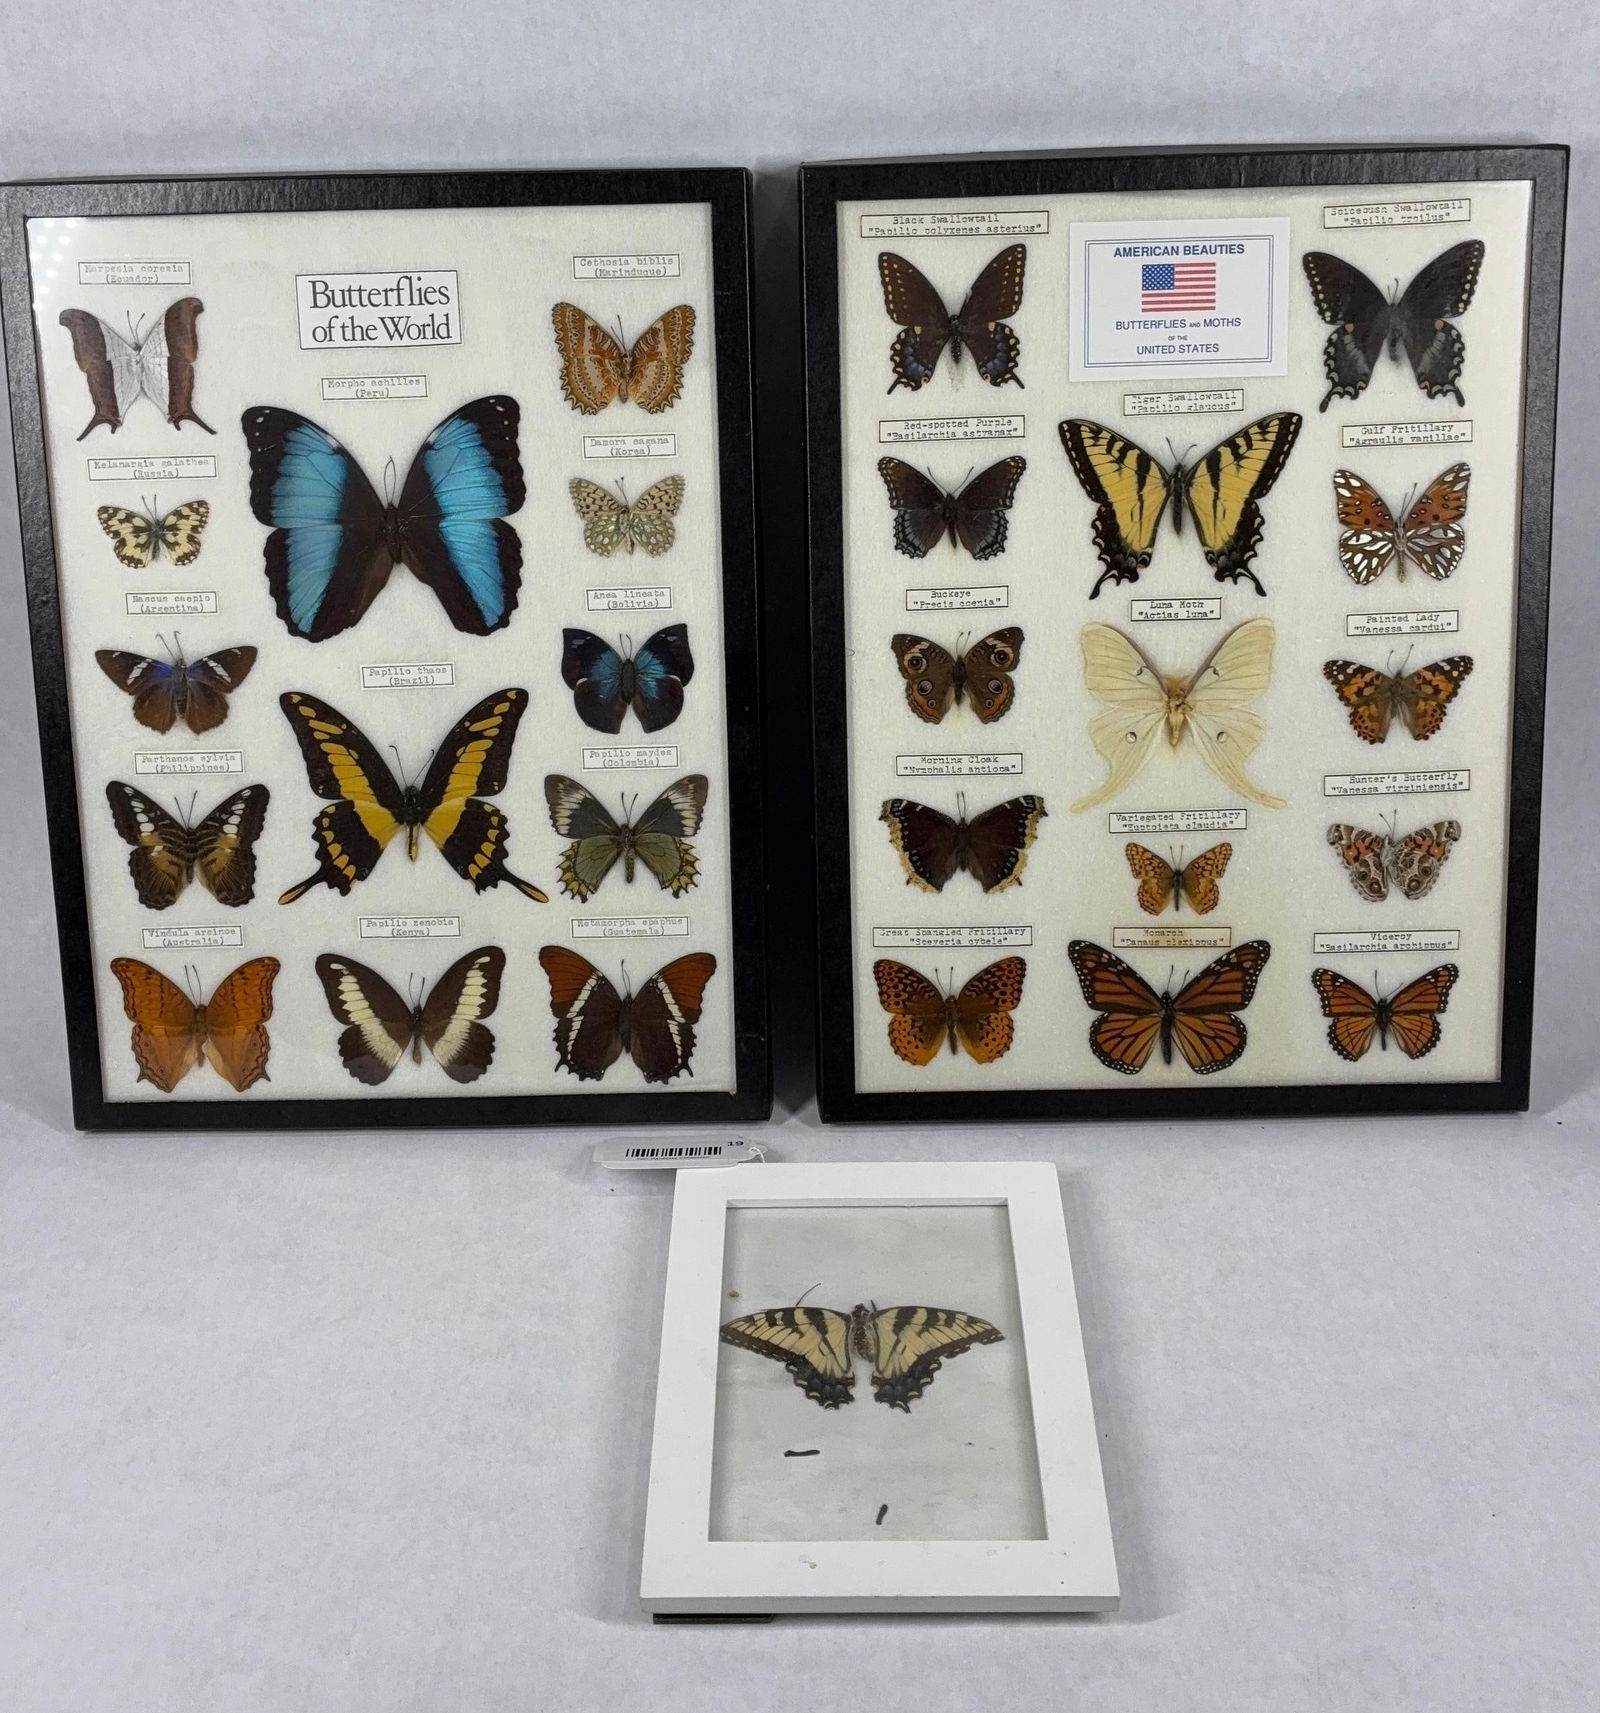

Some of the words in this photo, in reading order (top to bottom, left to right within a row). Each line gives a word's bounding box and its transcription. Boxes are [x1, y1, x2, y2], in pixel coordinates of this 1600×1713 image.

[1394, 201, 1463, 212] Swallowtail
[893, 216, 924, 224] Black
[930, 214, 999, 223] Swallowtail
[1114, 247, 1179, 257] AMERICAN
[1184, 244, 1245, 255] BEAUTIES
[580, 258, 630, 267] Cethosia
[637, 257, 673, 265] biblis
[308, 276, 450, 308] Butterflies
[312, 315, 339, 342] of
[340, 315, 377, 341] the
[378, 313, 452, 341] World
[1116, 319, 1187, 330] BUTTERFLIES
[1203, 318, 1241, 327] MOTHS
[1137, 346, 1176, 355] UNITED
[1179, 344, 1219, 353] STATES
[328, 380, 365, 389] Morpho
[355, 388, 389, 398] (Peru)
[1132, 395, 1161, 404] Tiger
[1168, 392, 1236, 401] Swallowtail
[904, 420, 968, 430] Red-spotted
[976, 419, 1012, 427] Purple
[1361, 426, 1385, 435] Gulf
[1392, 423, 1453, 433] Fritillary
[610, 446, 650, 456] (Korea)
[133, 469, 179, 479] (Russia)
[931, 590, 971, 598] Buckeye
[140, 604, 204, 614] (Argentina)
[607, 599, 658, 609] (Bolivia)
[914, 600, 954, 608] "Precis
[1180, 600, 1204, 608] Moth
[1186, 609, 1214, 618] luna"
[1366, 615, 1409, 623] Painted
[1415, 613, 1440, 622] Lady
[1355, 625, 1403, 633] "Vanessa
[1409, 622, 1451, 632] cardui"
[369, 669, 411, 677] Papilio
[389, 675, 435, 686] (Brazil)
[590, 750, 631, 758] Papilio
[603, 757, 660, 768] (Colombia)
[156, 763, 230, 773] (Philippines)
[1349, 775, 1397, 784] Hunter's
[1404, 773, 1458, 782] Butterfly
[1332, 786, 1379, 794] "Vanessa
[1116, 814, 1174, 822] Variegated
[1180, 811, 1240, 821] Fritillary
[413, 918, 454, 926] zenobia
[392, 928, 430, 937] (Kenya)
[603, 927, 665, 937] (Guatemala)
[969, 927, 1026, 936] Fritillary
[163, 937, 224, 947] (Australia)
[1371, 933, 1412, 941] Viceroy
